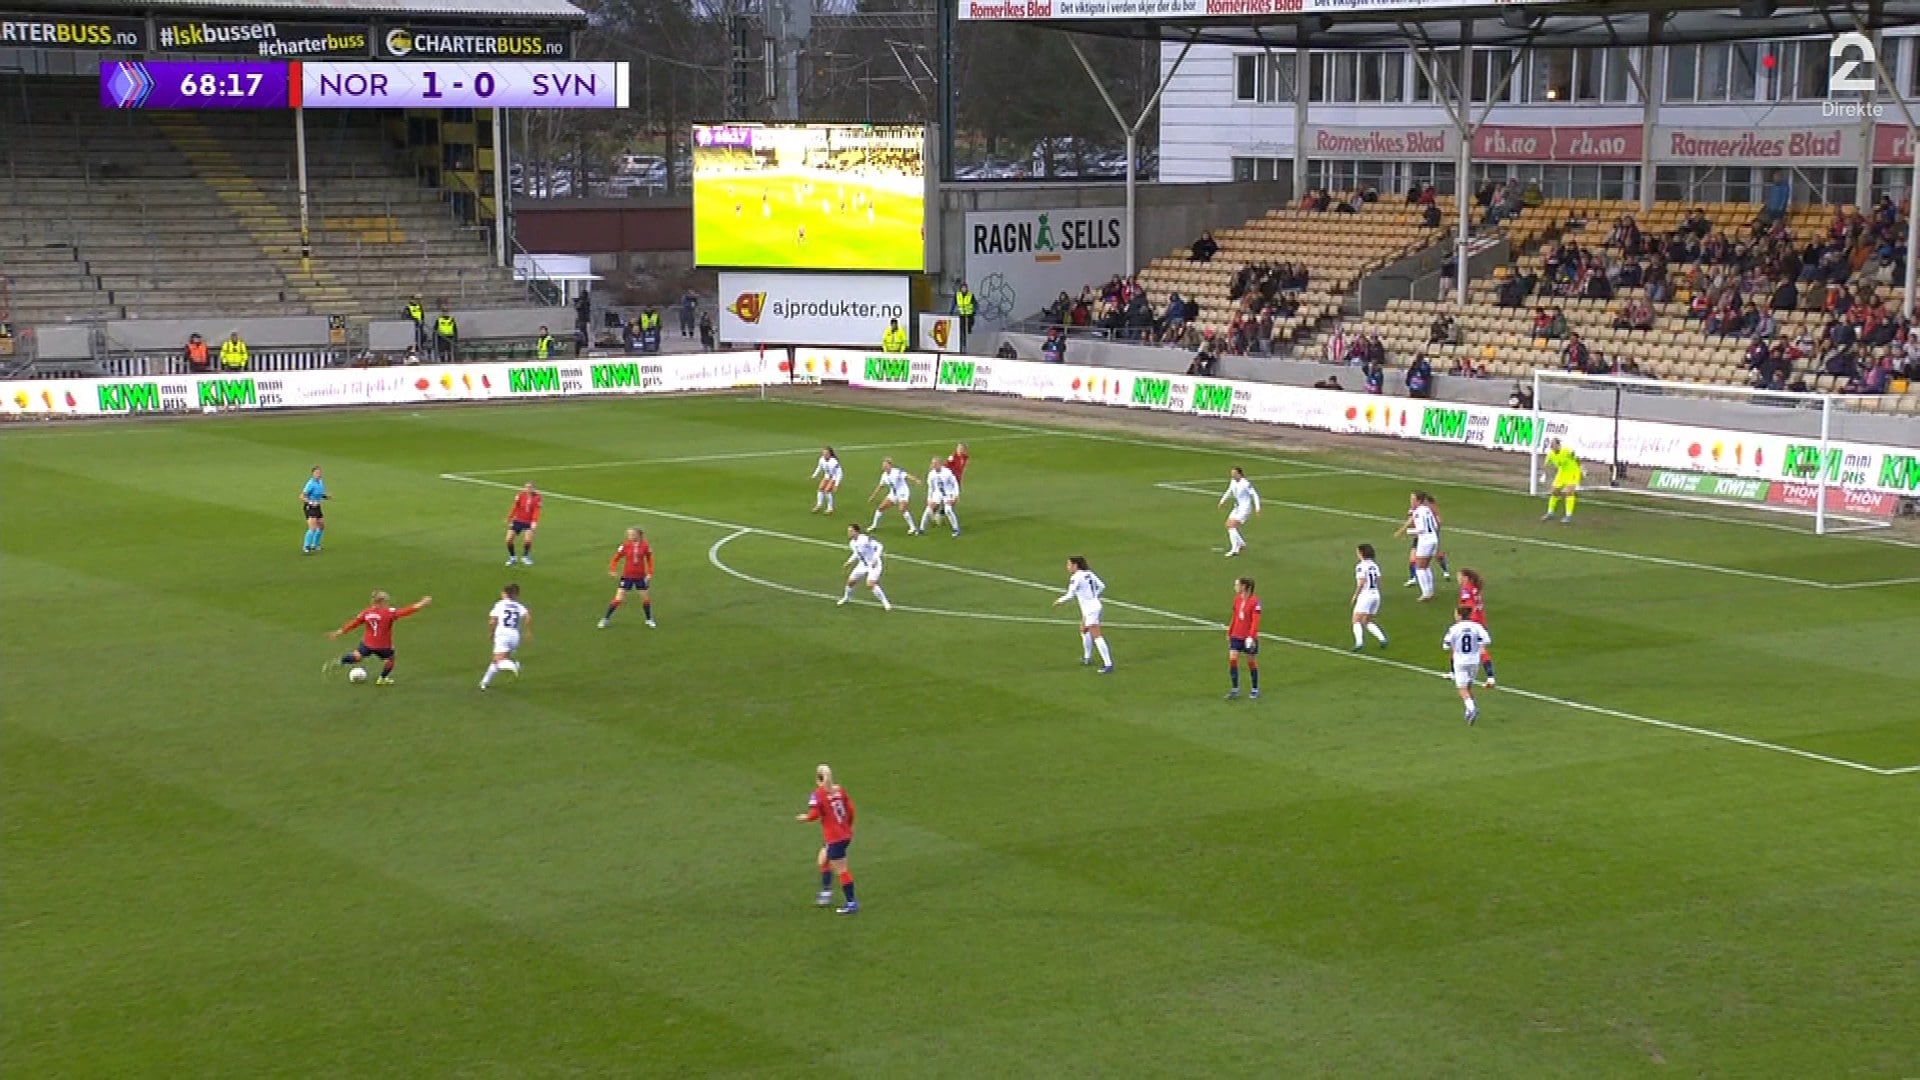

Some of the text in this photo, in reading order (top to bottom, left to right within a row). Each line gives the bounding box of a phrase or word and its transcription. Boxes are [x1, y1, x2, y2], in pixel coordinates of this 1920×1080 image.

[970, 0, 1052, 17] Romerikes Blad
[0, 21, 137, 45] RTERBUSS.no
[258, 33, 364, 56] #charterbuss
[414, 34, 563, 55] CHARTERBUSS.no
[1316, 129, 1445, 151] Romerikes Blad
[1484, 131, 1537, 154] rb.no
[1570, 132, 1625, 156] rb.no
[1671, 130, 1841, 157] Romerikes Blad
[974, 218, 1121, 254] RAGN SELLS
[773, 298, 903, 318] ajprodukter.no
[507, 366, 560, 392] KIWI
[590, 362, 641, 388] KIWI
[864, 357, 910, 382] KIWI
[939, 360, 975, 386] KIWI
[196, 378, 257, 406] KIWI
[257, 380, 282, 391] mini
[562, 380, 582, 392] pris
[642, 376, 662, 388] pris
[1132, 377, 1170, 405] KIWI
[97, 382, 187, 410] KIWI mini
[162, 395, 187, 409] pris
[259, 393, 282, 406] pris
[1192, 384, 1233, 412] KIWI
[1421, 406, 1467, 438] KIWI
[1494, 414, 1546, 448] KIWI
[1844, 454, 1871, 468] mini
[1656, 471, 1687, 489] KIWI
[1714, 477, 1746, 497] KIWI
[1844, 490, 1882, 506] THON
[504, 609, 519, 629] 23
[1461, 633, 1472, 654] 8
